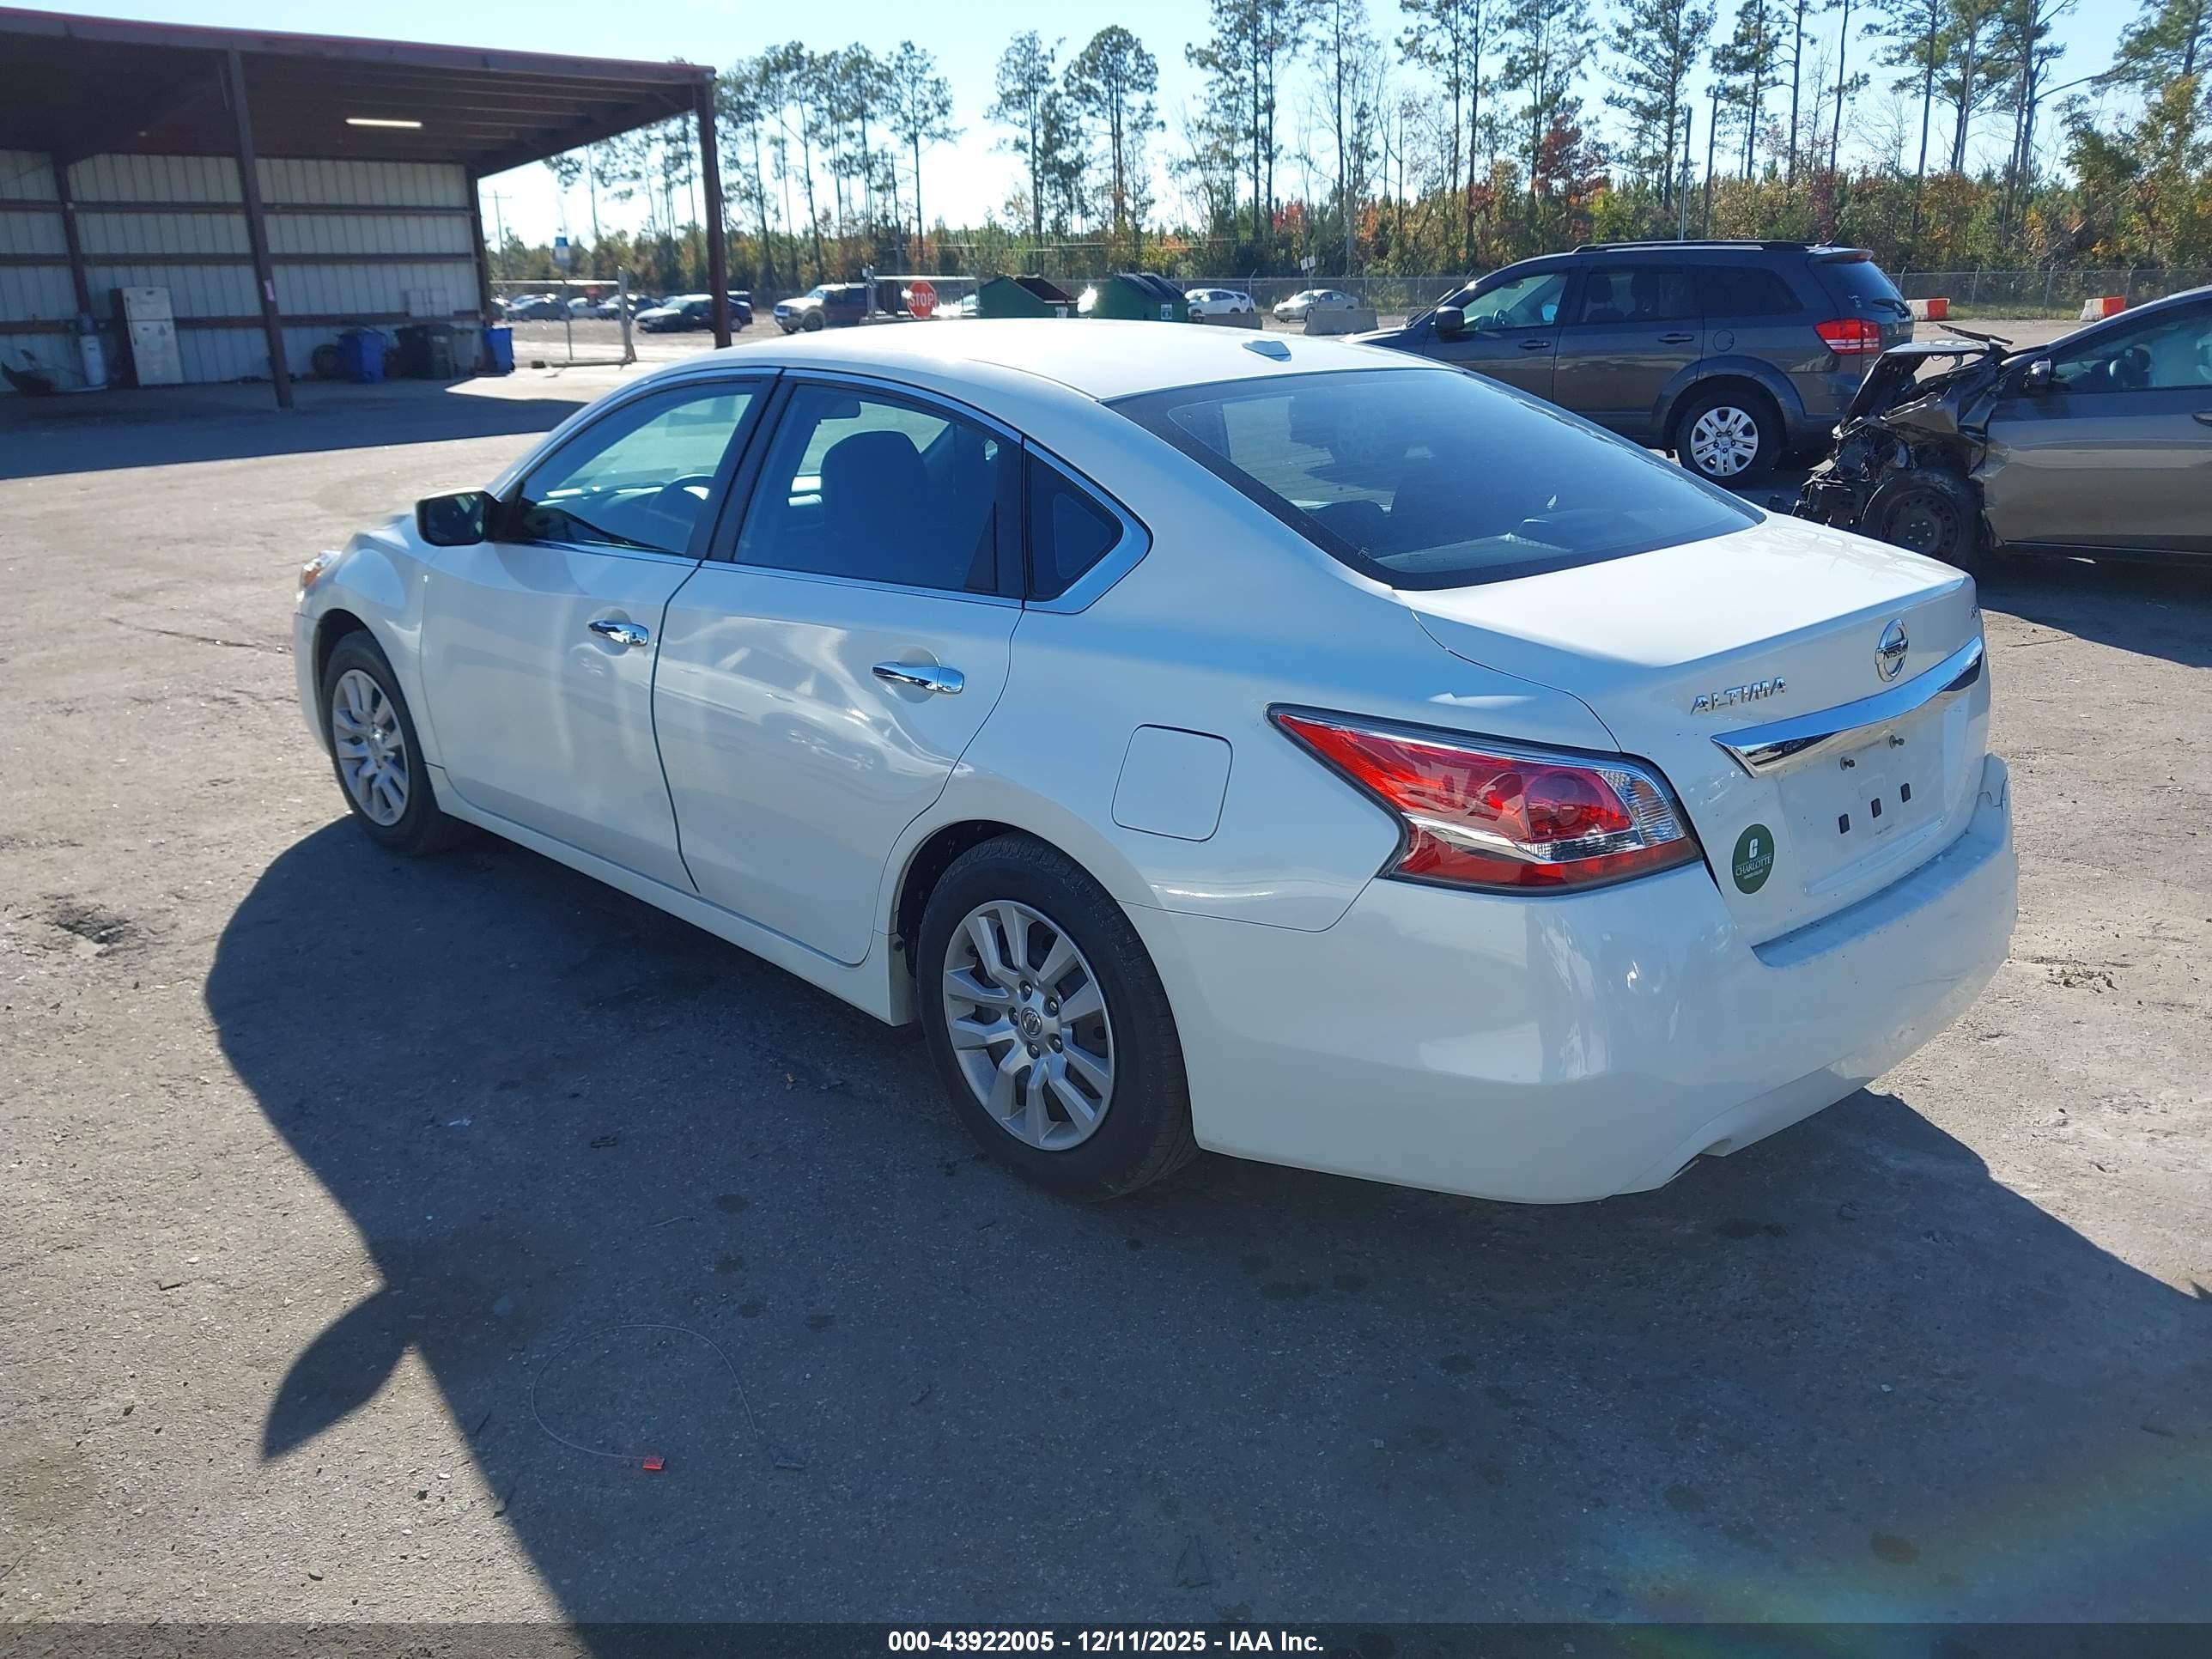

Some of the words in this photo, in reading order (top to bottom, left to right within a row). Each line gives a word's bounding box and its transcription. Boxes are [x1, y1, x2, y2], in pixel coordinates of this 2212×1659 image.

[910, 293, 934, 307] STOP
[1690, 677, 1786, 714] ALTIMA
[1735, 855, 1772, 876] CHARLOTTE
